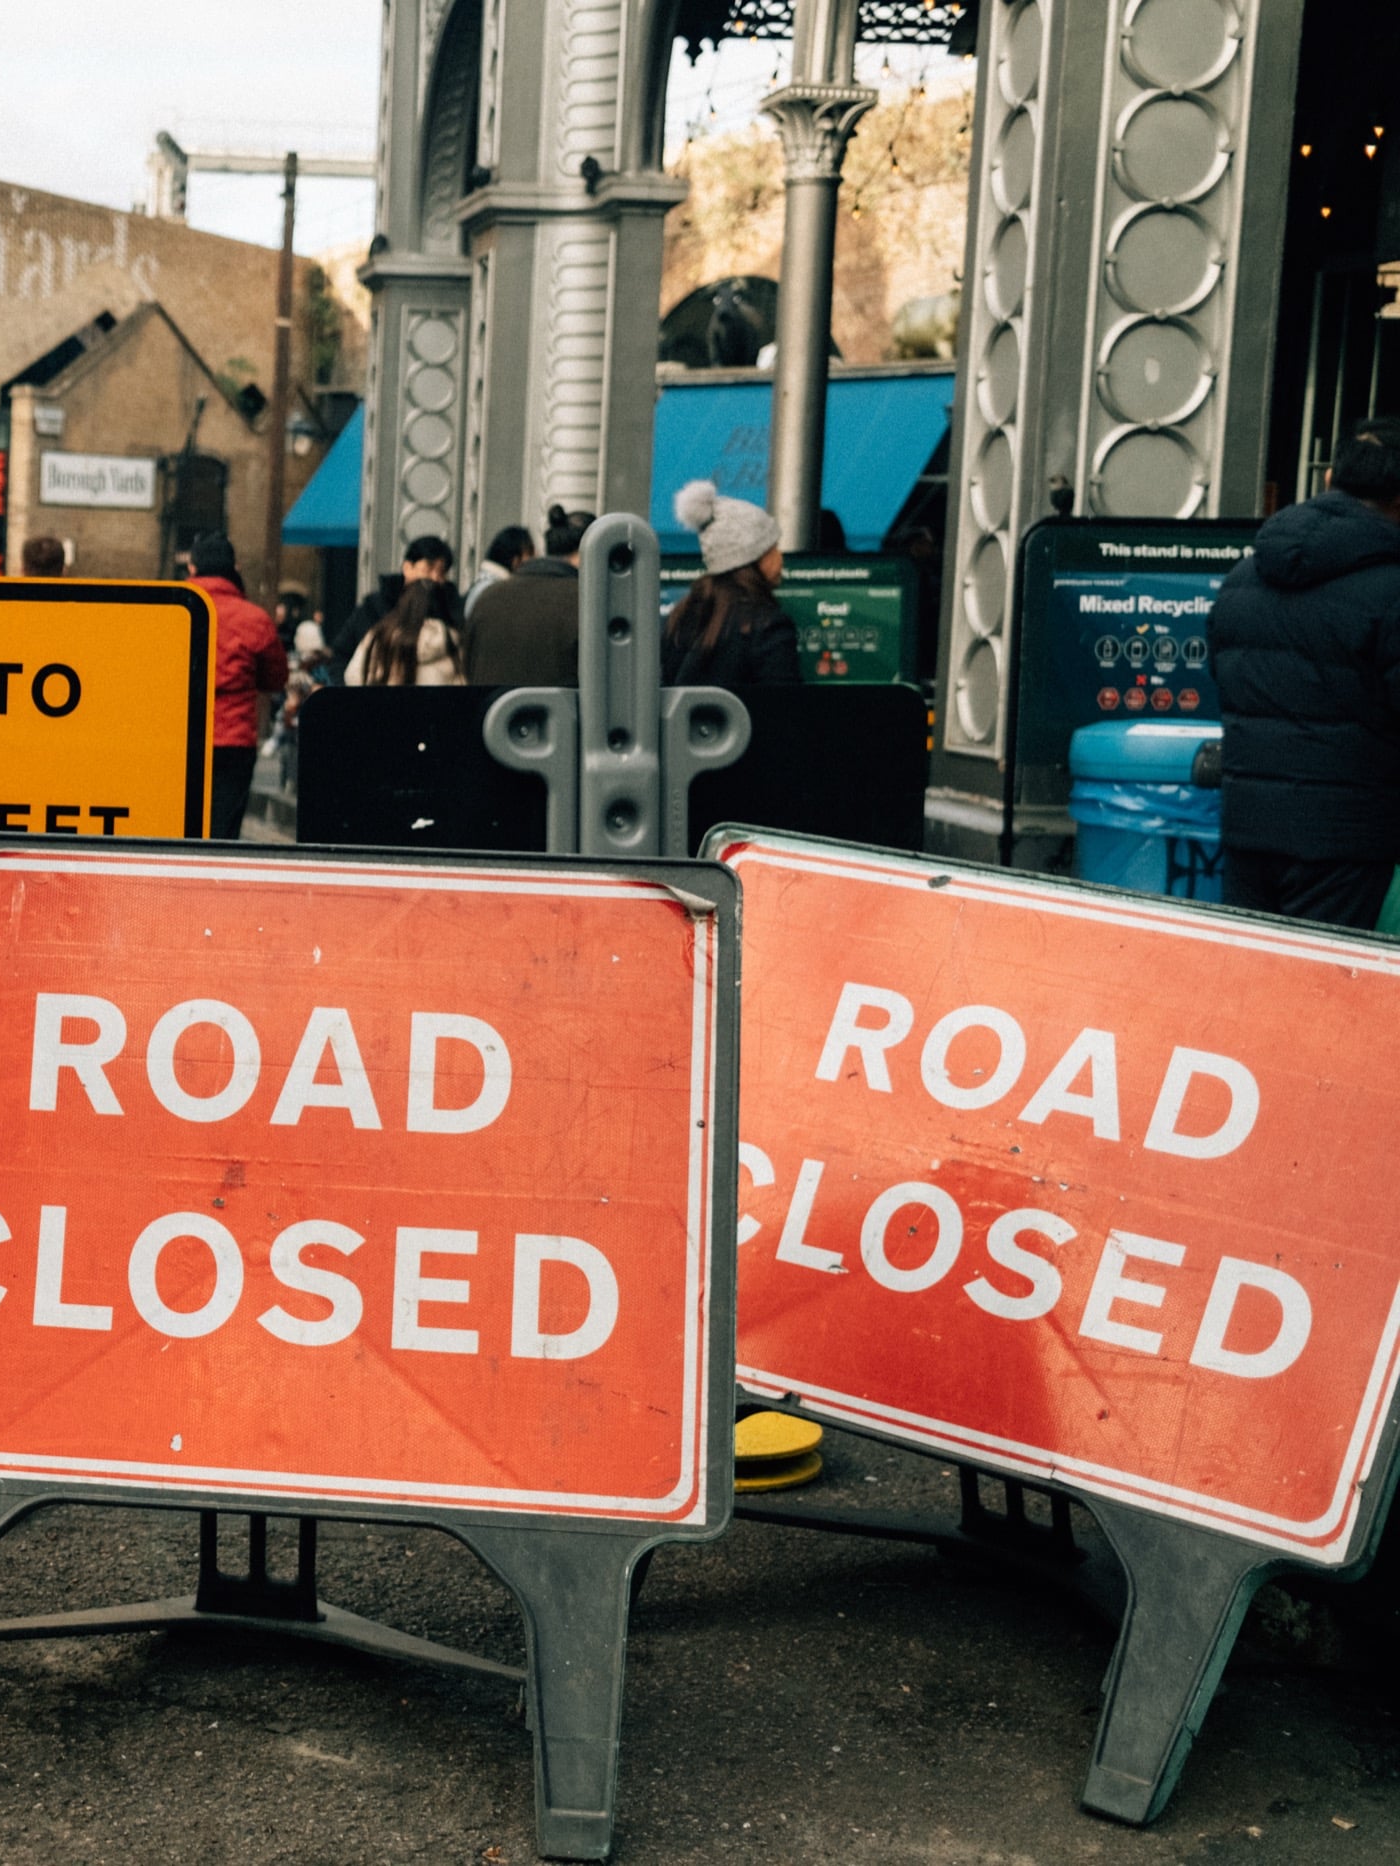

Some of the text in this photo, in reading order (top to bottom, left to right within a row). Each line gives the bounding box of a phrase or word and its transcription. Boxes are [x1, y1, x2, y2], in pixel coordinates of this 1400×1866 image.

[47, 463, 146, 494] Borough Yards
[1099, 542, 1132, 558] This
[1133, 544, 1178, 558] stand
[1180, 544, 1193, 559] is
[1195, 545, 1242, 560] made
[1079, 595, 1135, 614] Mixed
[29, 992, 513, 1134] ROAD
[814, 981, 1261, 1159] ROAD
